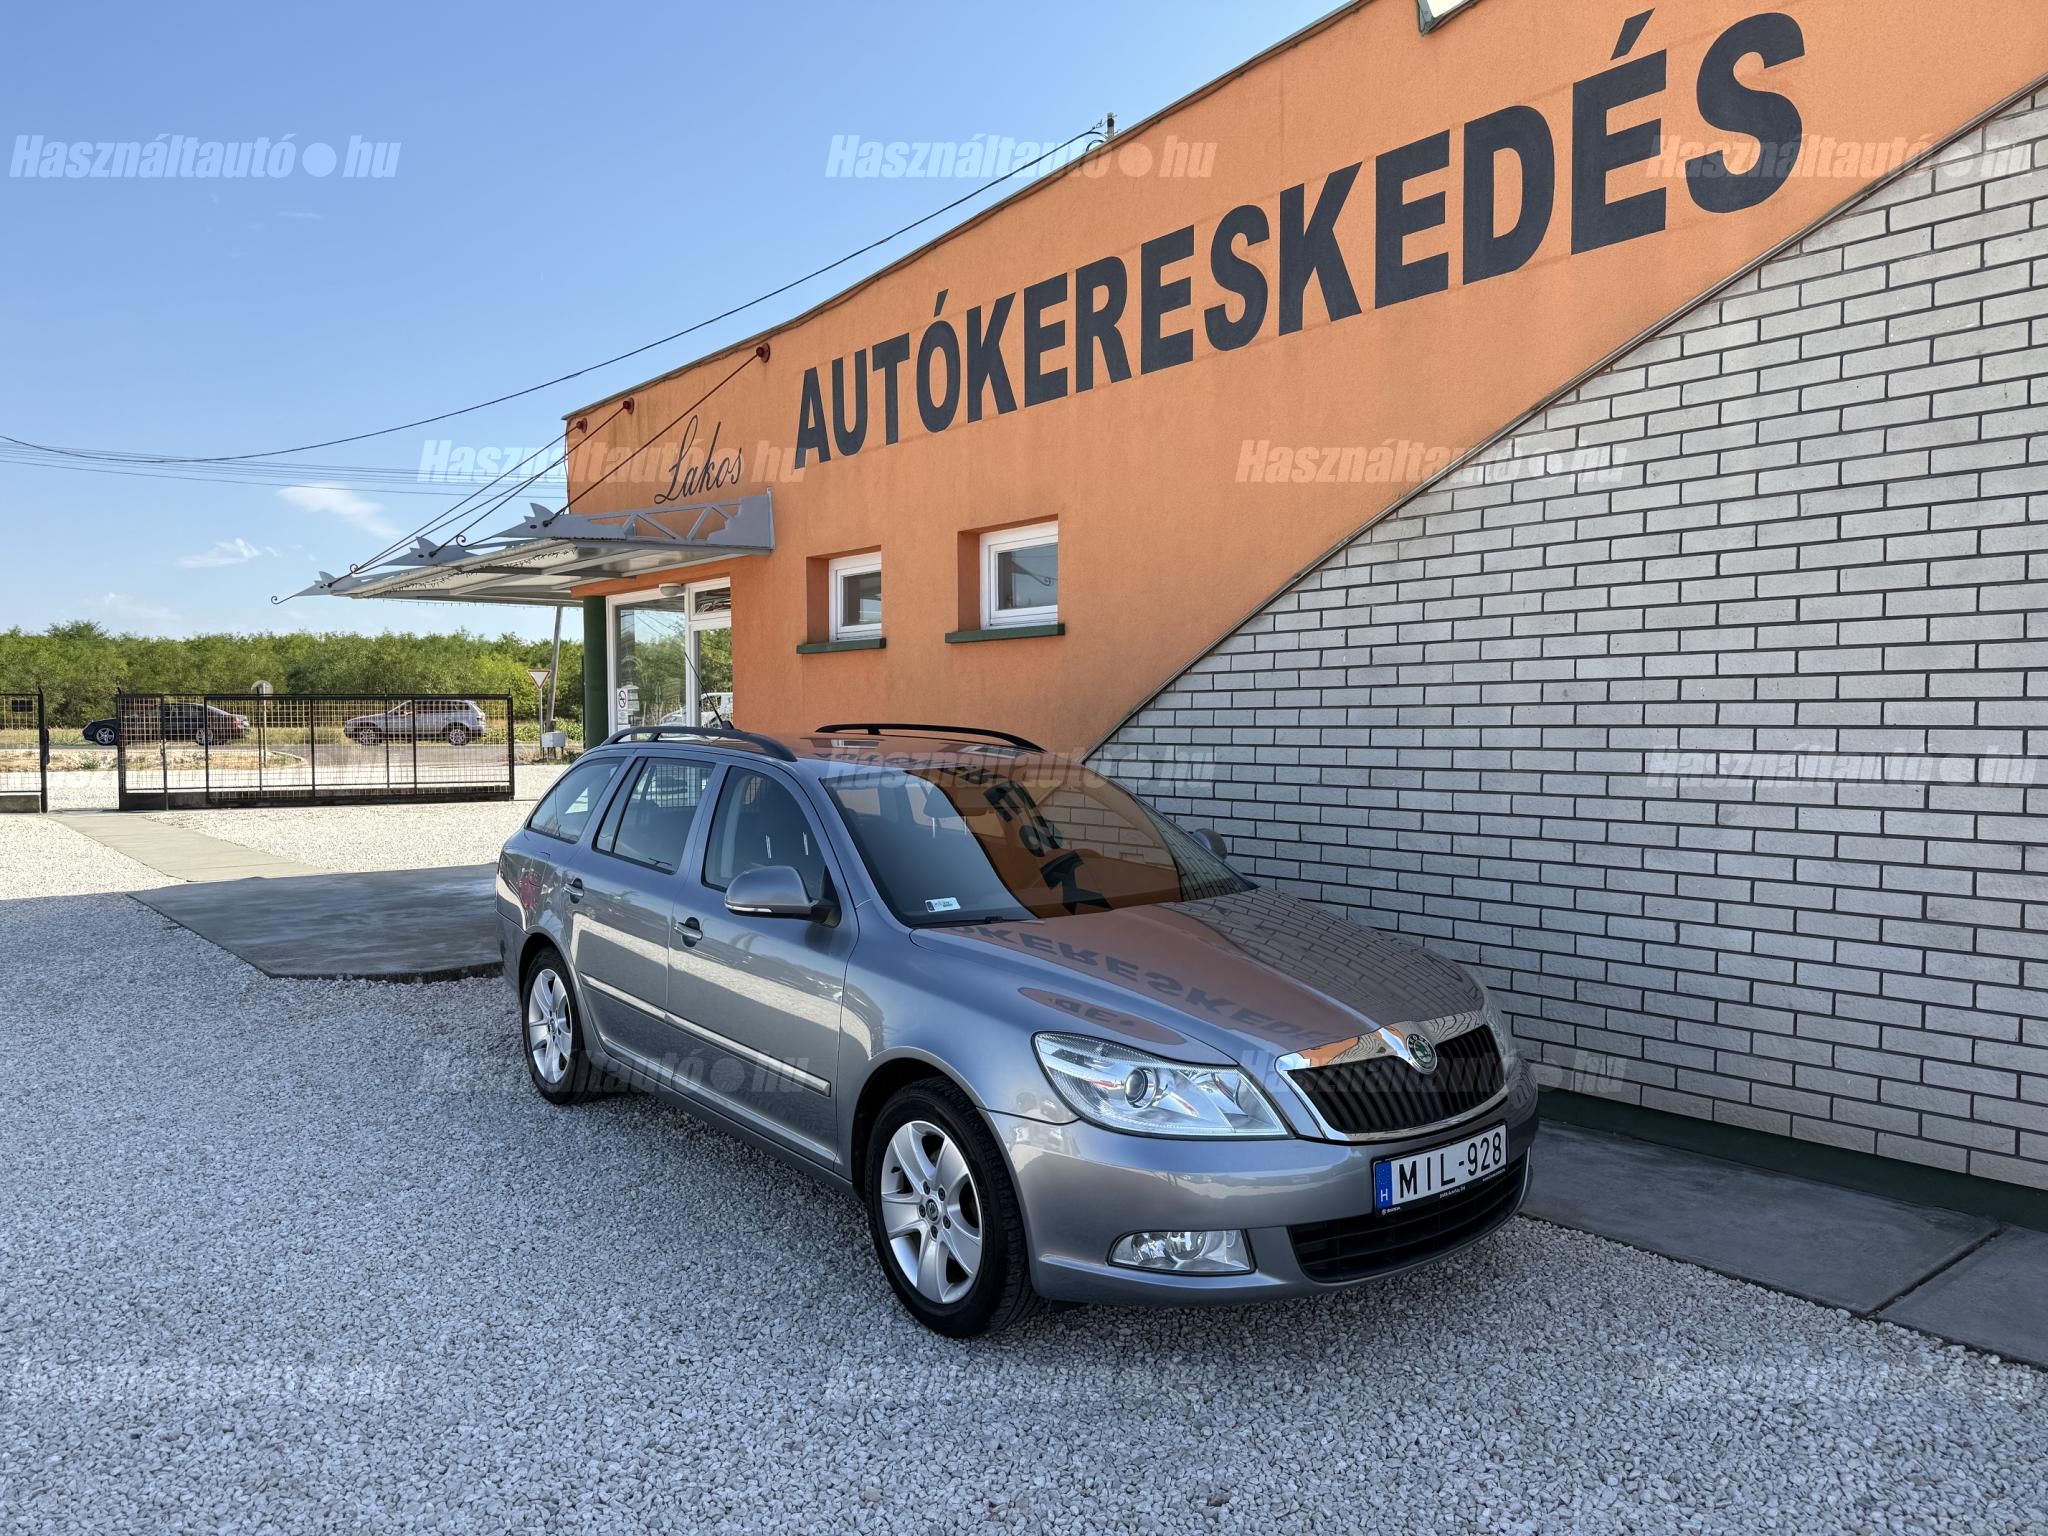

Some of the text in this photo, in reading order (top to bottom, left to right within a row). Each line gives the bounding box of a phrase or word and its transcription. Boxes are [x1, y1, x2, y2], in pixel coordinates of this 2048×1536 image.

[794, 8, 1806, 470] AUTÓKERESKEDÉS
[653, 414, 744, 504] Lakos
[1380, 1188, 1388, 1202] H
[1399, 1131, 1501, 1198] MIL-928
